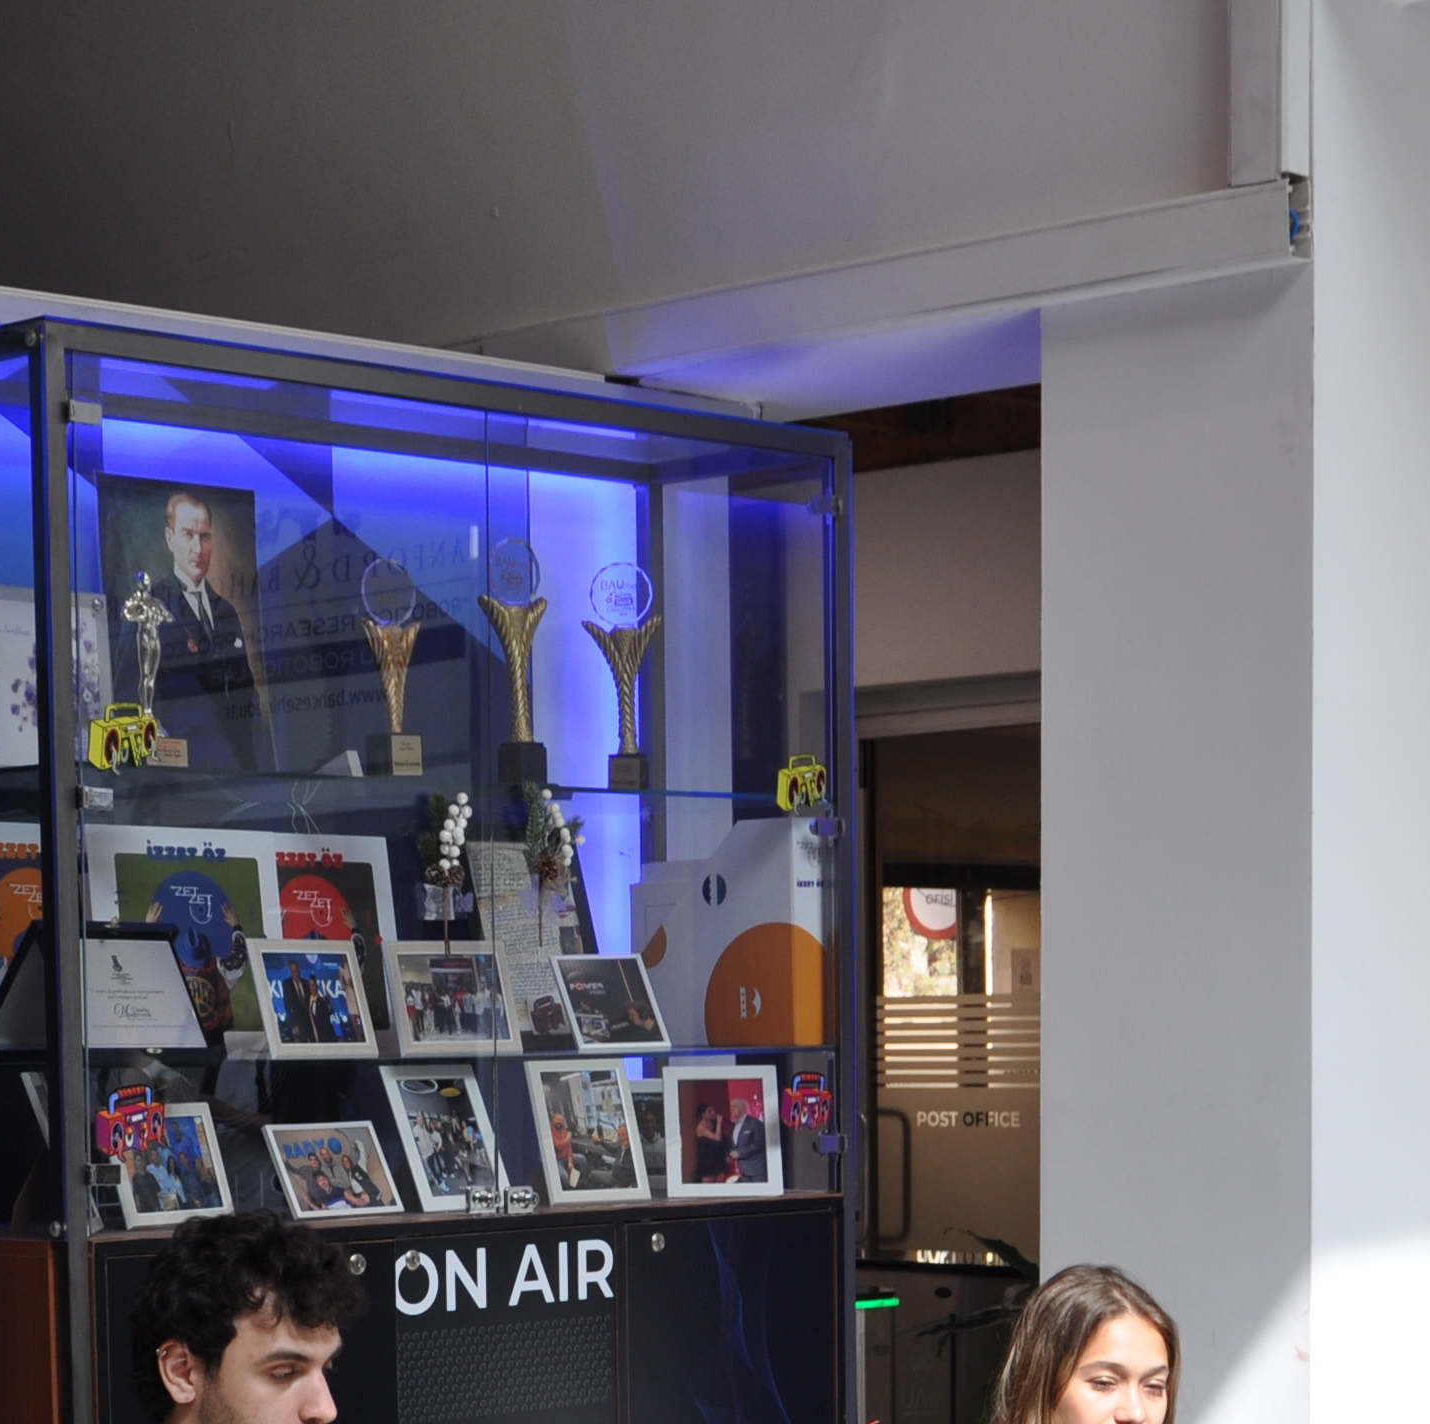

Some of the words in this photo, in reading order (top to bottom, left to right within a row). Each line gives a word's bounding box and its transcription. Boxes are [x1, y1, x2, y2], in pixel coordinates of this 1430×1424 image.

[275, 851, 317, 868] ZZET
[916, 1110, 957, 1128] POST
[962, 1110, 1020, 1128] OFFICE
[395, 1247, 487, 1316] ON
[508, 1239, 614, 1306] AIR
